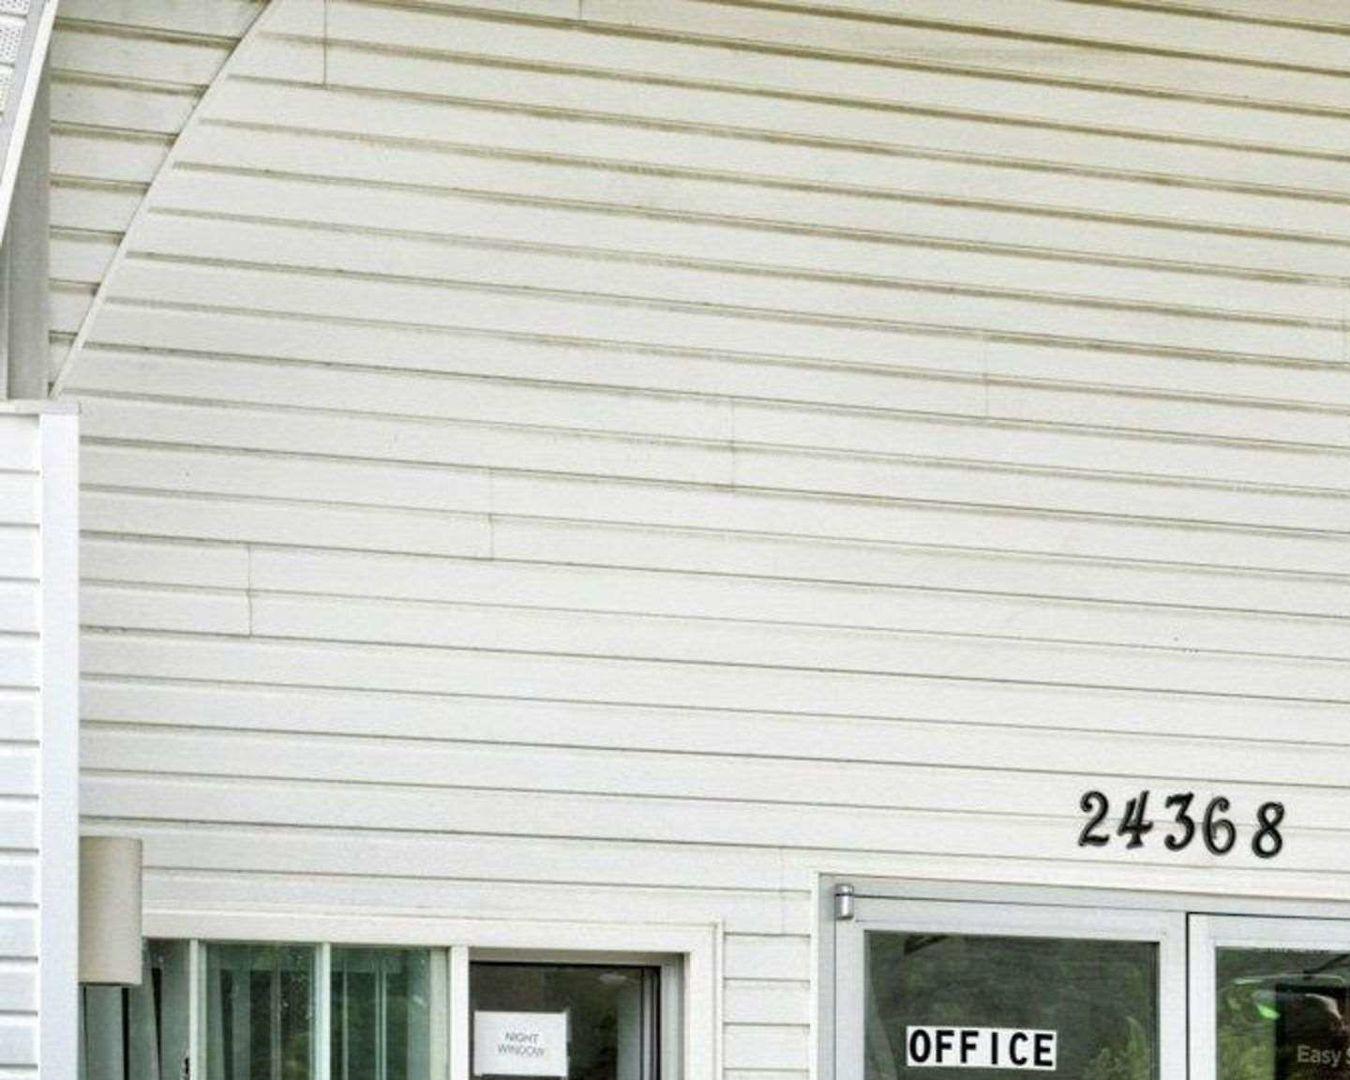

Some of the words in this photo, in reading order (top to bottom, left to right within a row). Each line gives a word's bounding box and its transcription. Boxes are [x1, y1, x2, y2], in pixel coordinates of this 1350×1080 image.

[1078, 790, 1285, 859] 24368
[504, 1032, 539, 1043] NIGHT
[909, 1029, 1054, 1067] OFFICE
[497, 1044, 544, 1057] WINDOW
[1297, 1045, 1342, 1068] Easy
